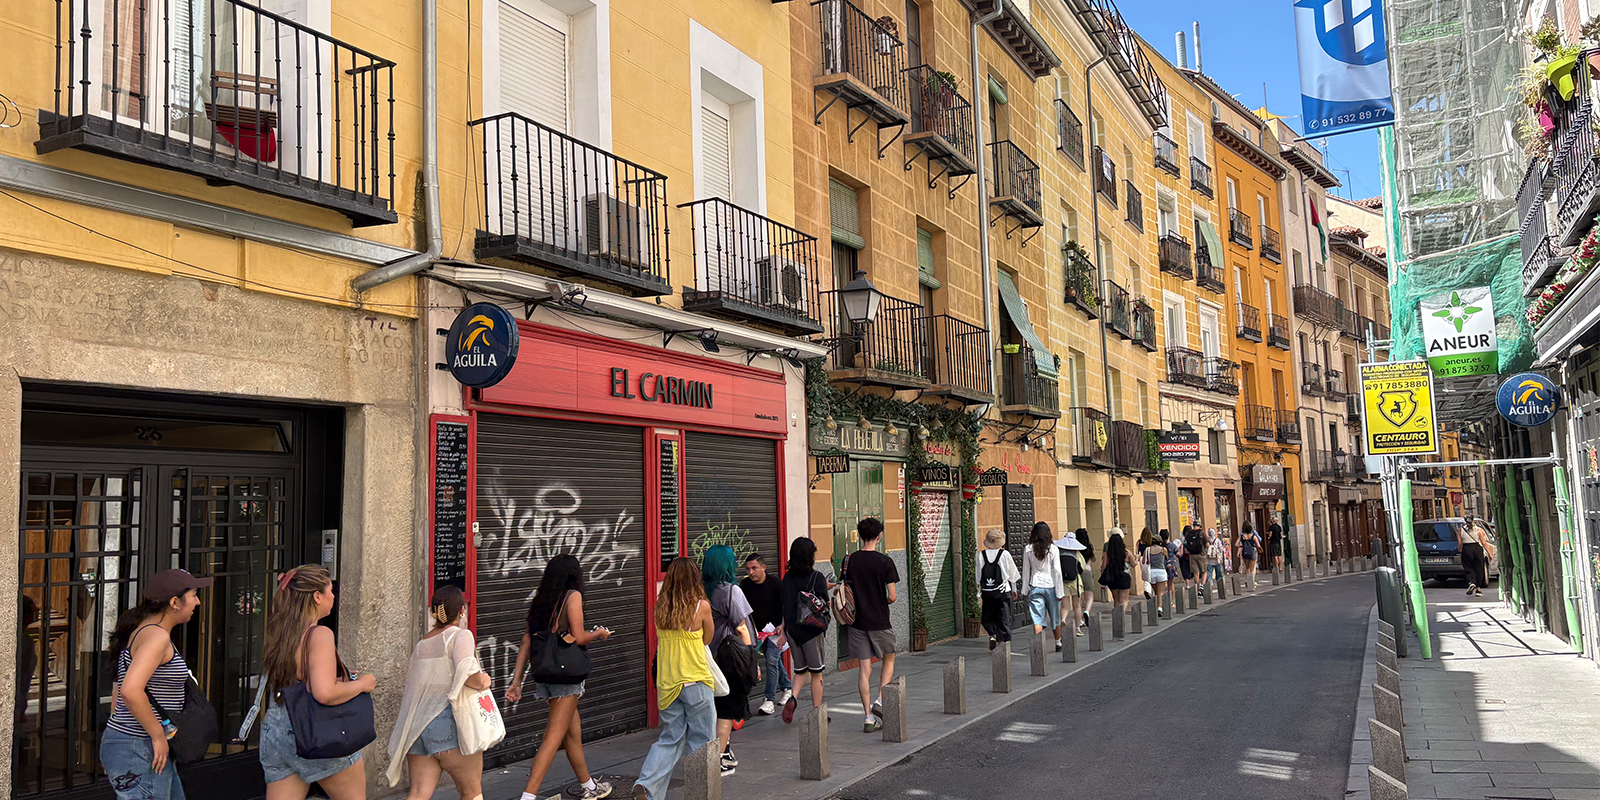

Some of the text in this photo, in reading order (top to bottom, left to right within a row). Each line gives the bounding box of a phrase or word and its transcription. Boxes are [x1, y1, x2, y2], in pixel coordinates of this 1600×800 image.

[1322, 107, 1387, 127] 91 532 89 77
[1430, 334, 1490, 352] ANEUR
[453, 352, 498, 368] ÁGUILA
[1446, 356, 1482, 366] aneur.es
[1452, 366, 1467, 374] 875
[611, 366, 713, 409] EL CARMIN
[1508, 404, 1551, 416] ÁGUILA
[841, 427, 851, 450] LA
[1375, 433, 1427, 442] CENTAURO
[817, 456, 848, 473] TABERNA
[922, 467, 948, 480] VINOS
[981, 473, 1007, 485] REGALOS
